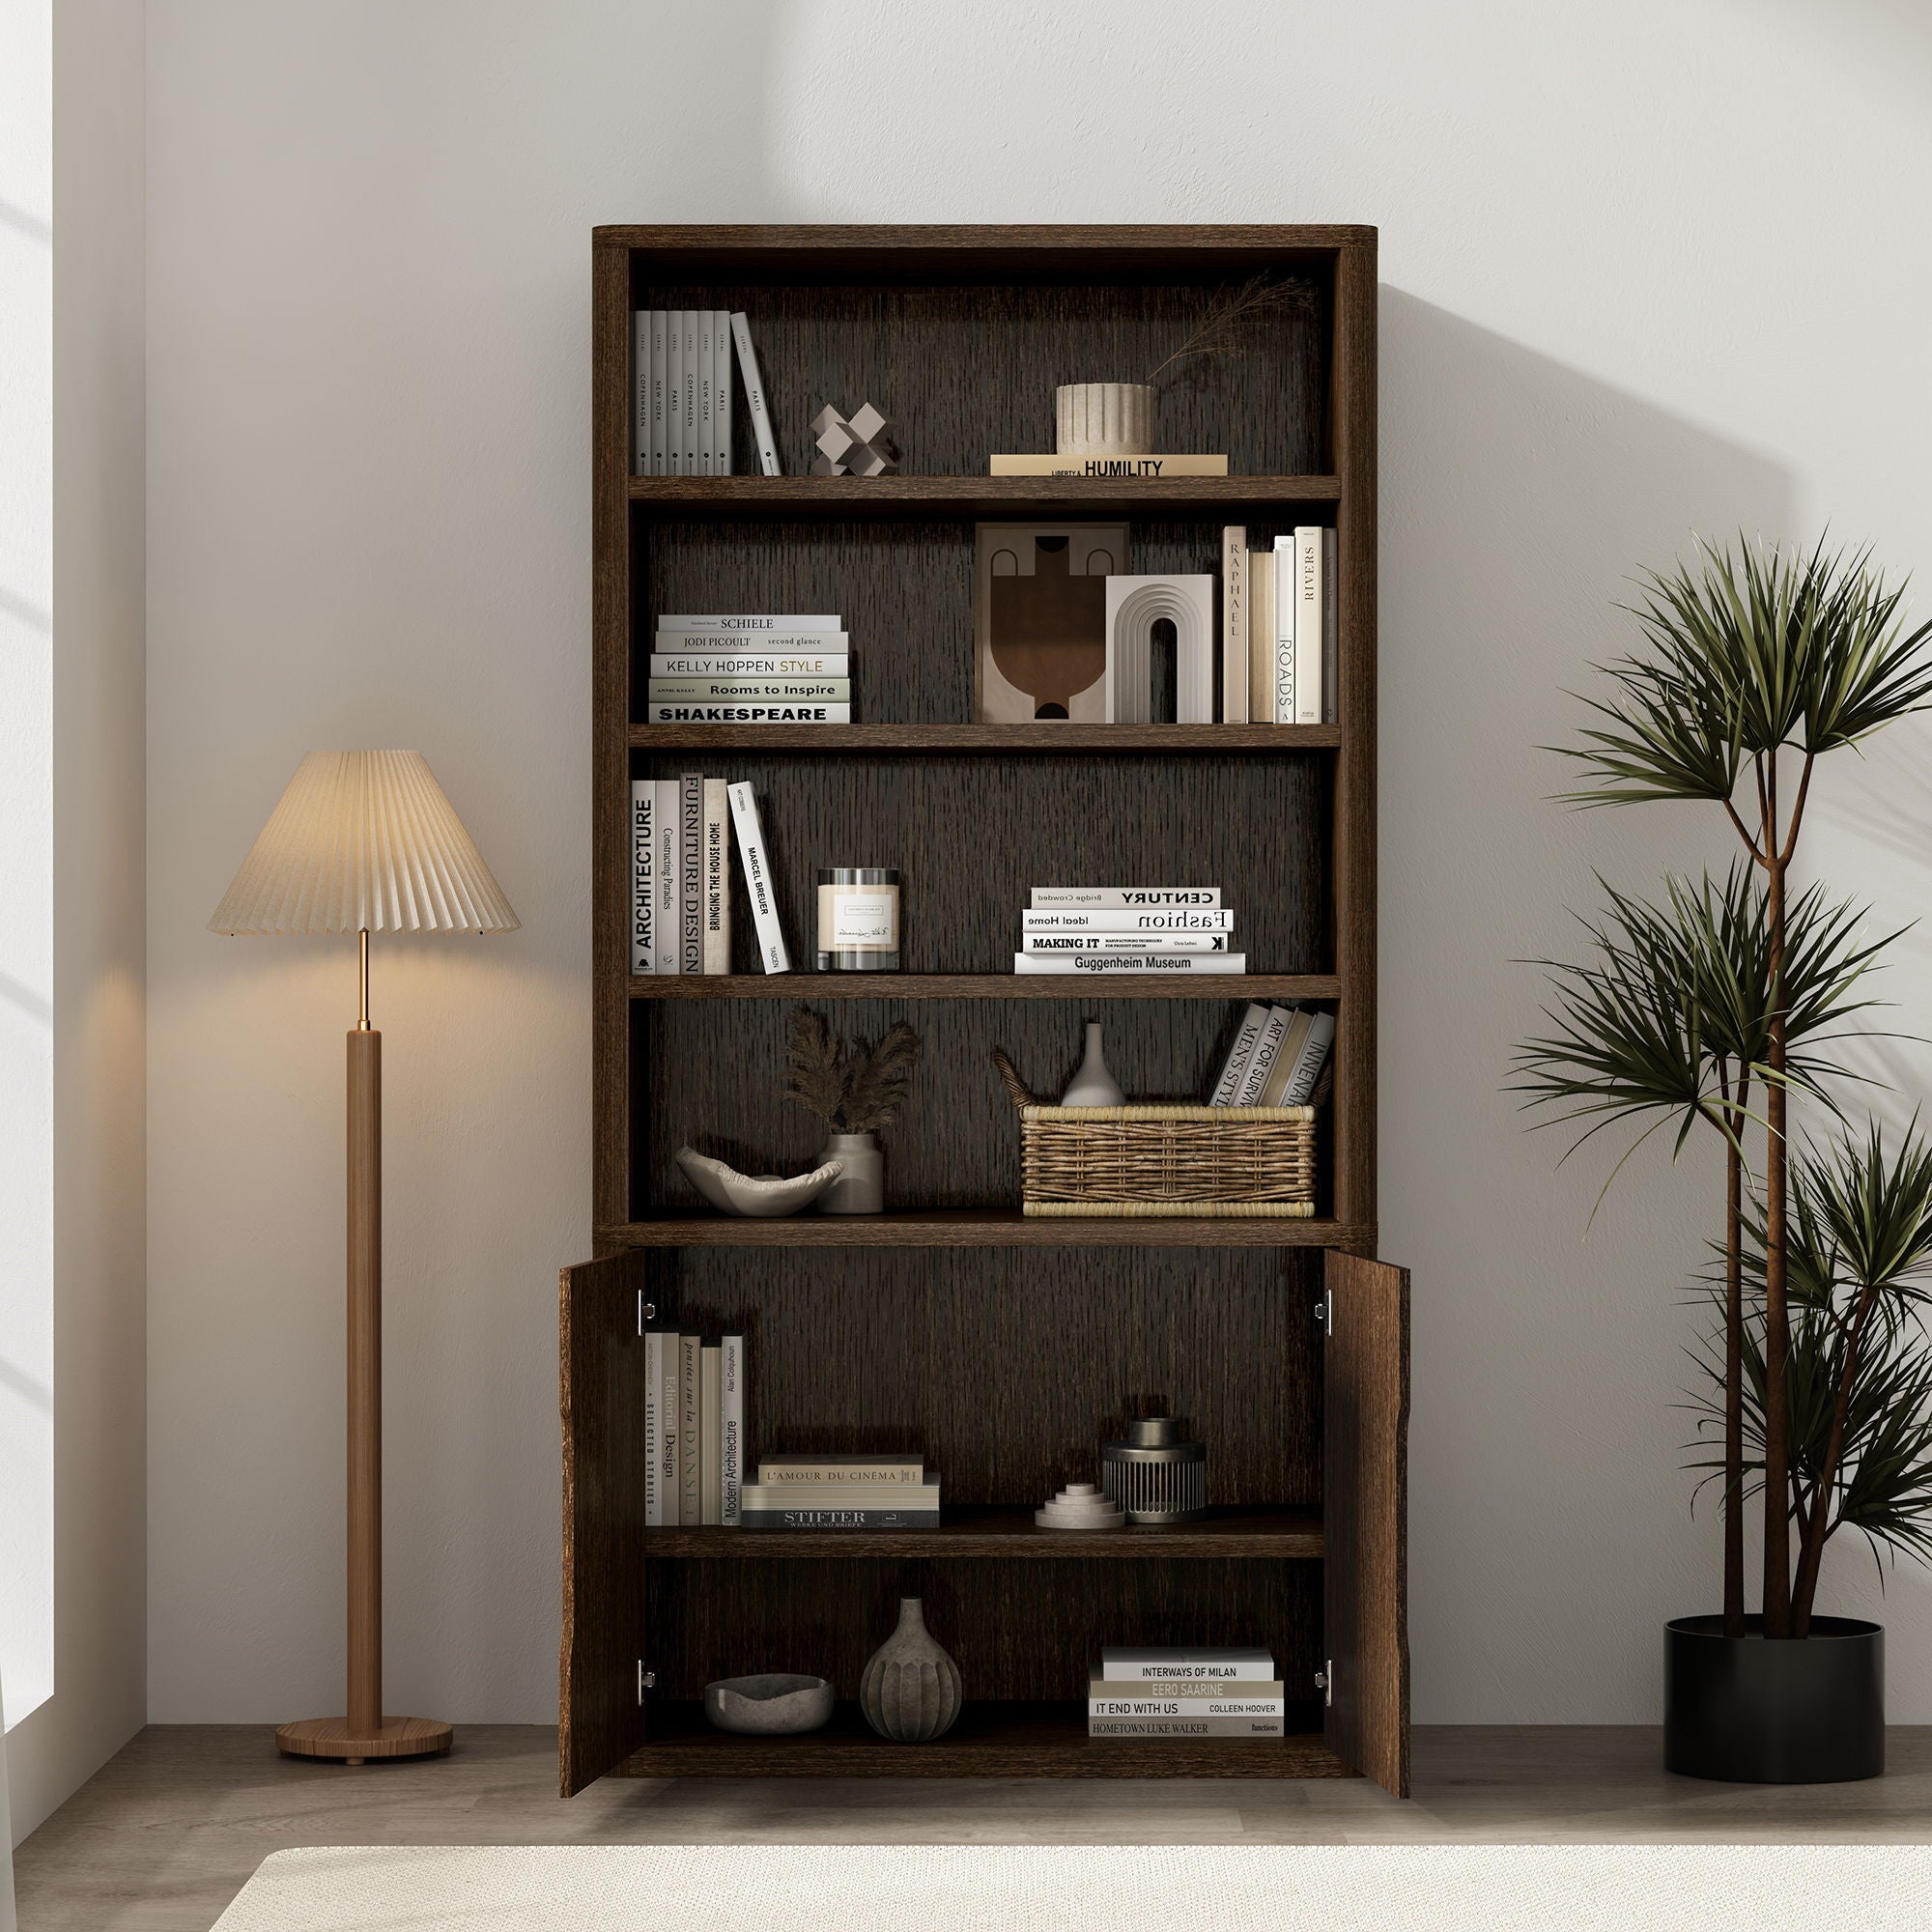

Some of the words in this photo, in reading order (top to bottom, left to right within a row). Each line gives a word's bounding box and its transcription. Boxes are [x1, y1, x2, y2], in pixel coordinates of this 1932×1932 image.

[752, 390, 761, 412] PARIS
[1085, 460, 1163, 476] HUMILITY
[1304, 547, 1314, 601] RIVERS
[1231, 544, 1240, 637] RAPHAEL
[721, 618, 773, 628] SCHIELE
[684, 638, 705, 647] JODI
[709, 638, 751, 646] PICOULT
[796, 638, 821, 646] glance
[667, 661, 711, 672] KELLY
[717, 661, 775, 672] HOPPEN
[781, 661, 823, 672] STYLE
[1279, 639, 1293, 706] ROADS
[711, 686, 759, 695] Rooms
[765, 686, 781, 695] to
[784, 685, 835, 696] Inspire
[659, 708, 827, 721] SHAKESPEARE
[686, 777, 698, 893] FURNITURE
[709, 823, 721, 844] HOME
[661, 828, 672, 876] Constructing
[709, 846, 721, 873] HOUSE
[636, 800, 651, 949] ARCHITECTURE
[709, 875, 721, 891] THE
[748, 847, 761, 881] MARCEL
[755, 883, 769, 916] BREUER
[663, 878, 672, 910] Paradies
[709, 893, 721, 931] BRINGING
[686, 899, 698, 972] DESIGN
[1034, 939, 1084, 949] MAKING
[1086, 939, 1099, 949] IT
[1074, 956, 1142, 971] Guggenheim
[1146, 956, 1191, 968] Museum
[1267, 1018, 1285, 1041] ART
[1231, 1024, 1258, 1070] MEN'S
[1256, 1043, 1275, 1068] FOR
[685, 1343, 694, 1383] pensées
[665, 1376, 676, 1430] Editorial
[686, 1410, 694, 1422] la
[663, 1435, 676, 1478] Design
[726, 1420, 736, 1478] Architecture
[686, 1430, 696, 1503] DANSE
[726, 1480, 736, 1518] Modern
[784, 1512, 866, 1522] STIFTER
[1142, 1667, 1192, 1677] INTERWAYS
[1195, 1667, 1206, 1677] OF
[1208, 1667, 1236, 1677] MILAN
[1151, 1684, 1179, 1696] EERO
[1180, 1684, 1224, 1696] SAARINE
[1096, 1704, 1105, 1714] IT
[1109, 1704, 1131, 1714] END
[1134, 1704, 1161, 1714] WITH
[1164, 1704, 1179, 1714] US
[1209, 1704, 1243, 1713] COLLEEN
[1246, 1704, 1276, 1713] HOOVER
[1094, 1723, 1146, 1733] HOMETOWN
[1147, 1723, 1171, 1733] LUKE
[1172, 1723, 1208, 1733] WALKER
[1252, 1723, 1278, 1732] functions
